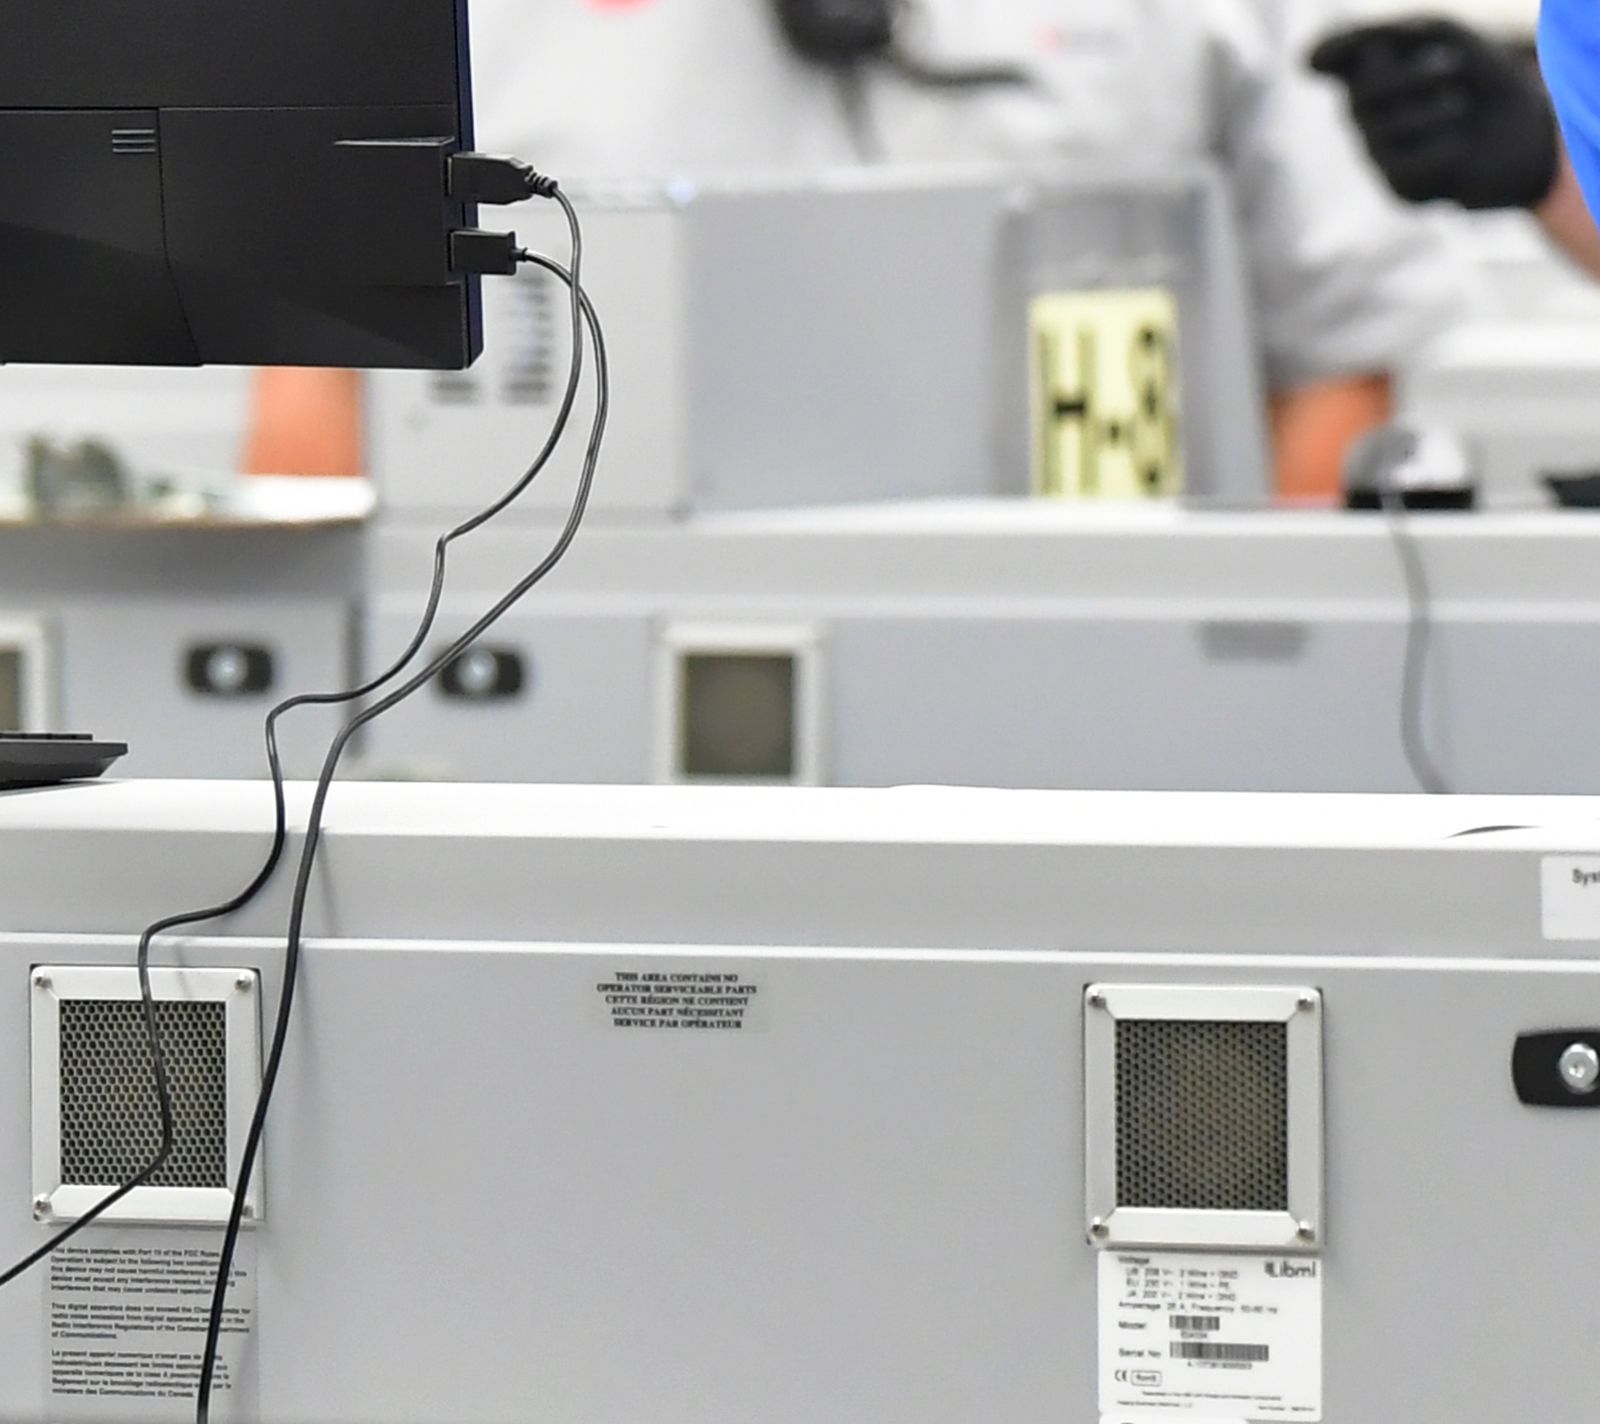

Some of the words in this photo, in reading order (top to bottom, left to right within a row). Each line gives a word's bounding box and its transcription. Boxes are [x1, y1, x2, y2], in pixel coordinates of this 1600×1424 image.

[615, 972, 639, 982] THIS
[641, 973, 668, 983] AREA
[670, 973, 722, 983] CONTAINS
[723, 974, 739, 983] NO
[596, 983, 651, 993] OPERATOR
[653, 984, 723, 994] SERVICEABLE
[725, 985, 757, 994] PARTS
[605, 995, 638, 1005] CETTE
[682, 996, 695, 1005] NE
[697, 996, 749, 1006] CONTIENT
[611, 1007, 646, 1017] AUCUN
[647, 1007, 674, 1017] PART
[613, 1018, 657, 1028] SERVICE
[658, 1019, 679, 1028] PAR
